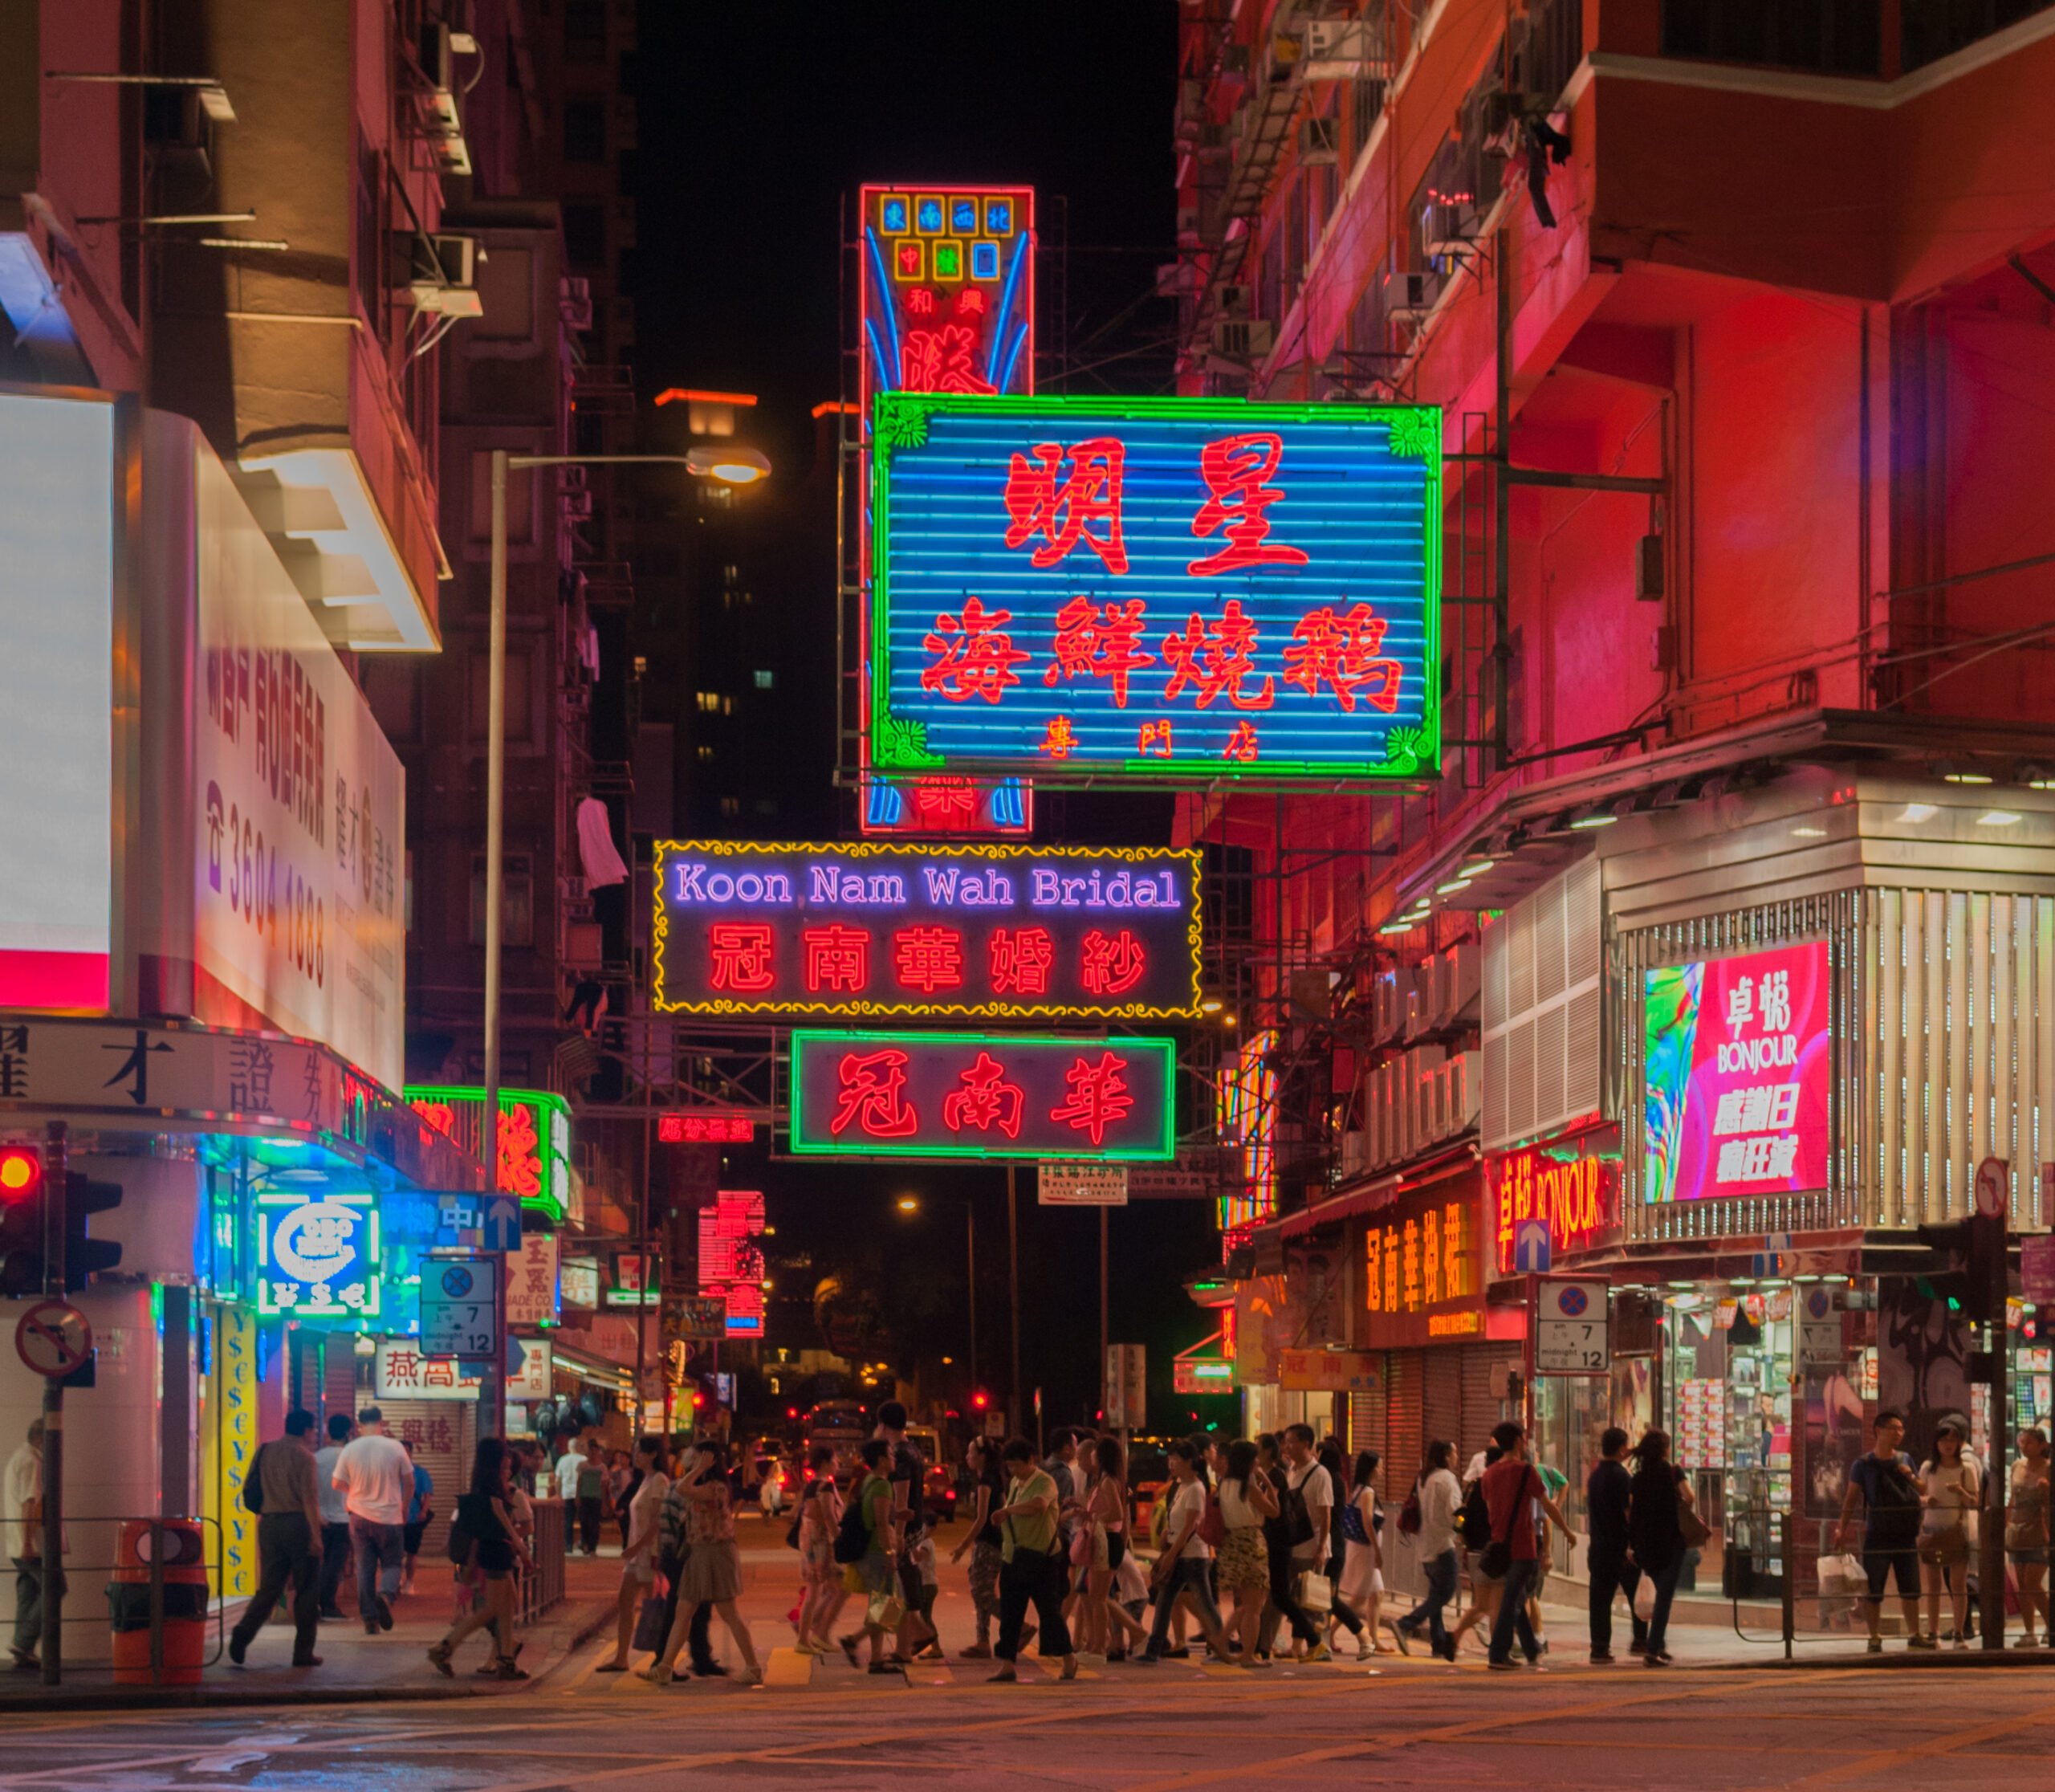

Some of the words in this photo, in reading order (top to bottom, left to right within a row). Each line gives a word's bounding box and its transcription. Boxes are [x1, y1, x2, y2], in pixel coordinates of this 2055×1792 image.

[885, 202, 1009, 230] 東南西北
[1005, 433, 1309, 576] 明星
[921, 596, 1403, 712] 海鮮燒鵝
[1040, 715, 1259, 762] 專門店
[230, 802, 276, 948] 3604
[286, 863, 324, 990] 1888
[677, 865, 791, 903] Koon
[810, 866, 905, 904] Nam
[924, 868, 1013, 906] Wah
[1032, 870, 1182, 908] Bridal
[711, 925, 1145, 994] 冠南華婚紗
[1718, 1034, 1798, 1075] BONJOUR
[832, 1050, 1135, 1146] 冠南華
[1713, 1082, 1800, 1135] 感謝日
[1537, 1156, 1598, 1248] BONJOUR
[467, 1306, 478, 1323] 7
[1581, 1325, 1593, 1340] 7
[469, 1334, 489, 1350] 12
[1542, 1349, 1577, 1357] midnight
[1582, 1350, 1602, 1366] 12
[531, 1349, 543, 1391] 專門店
